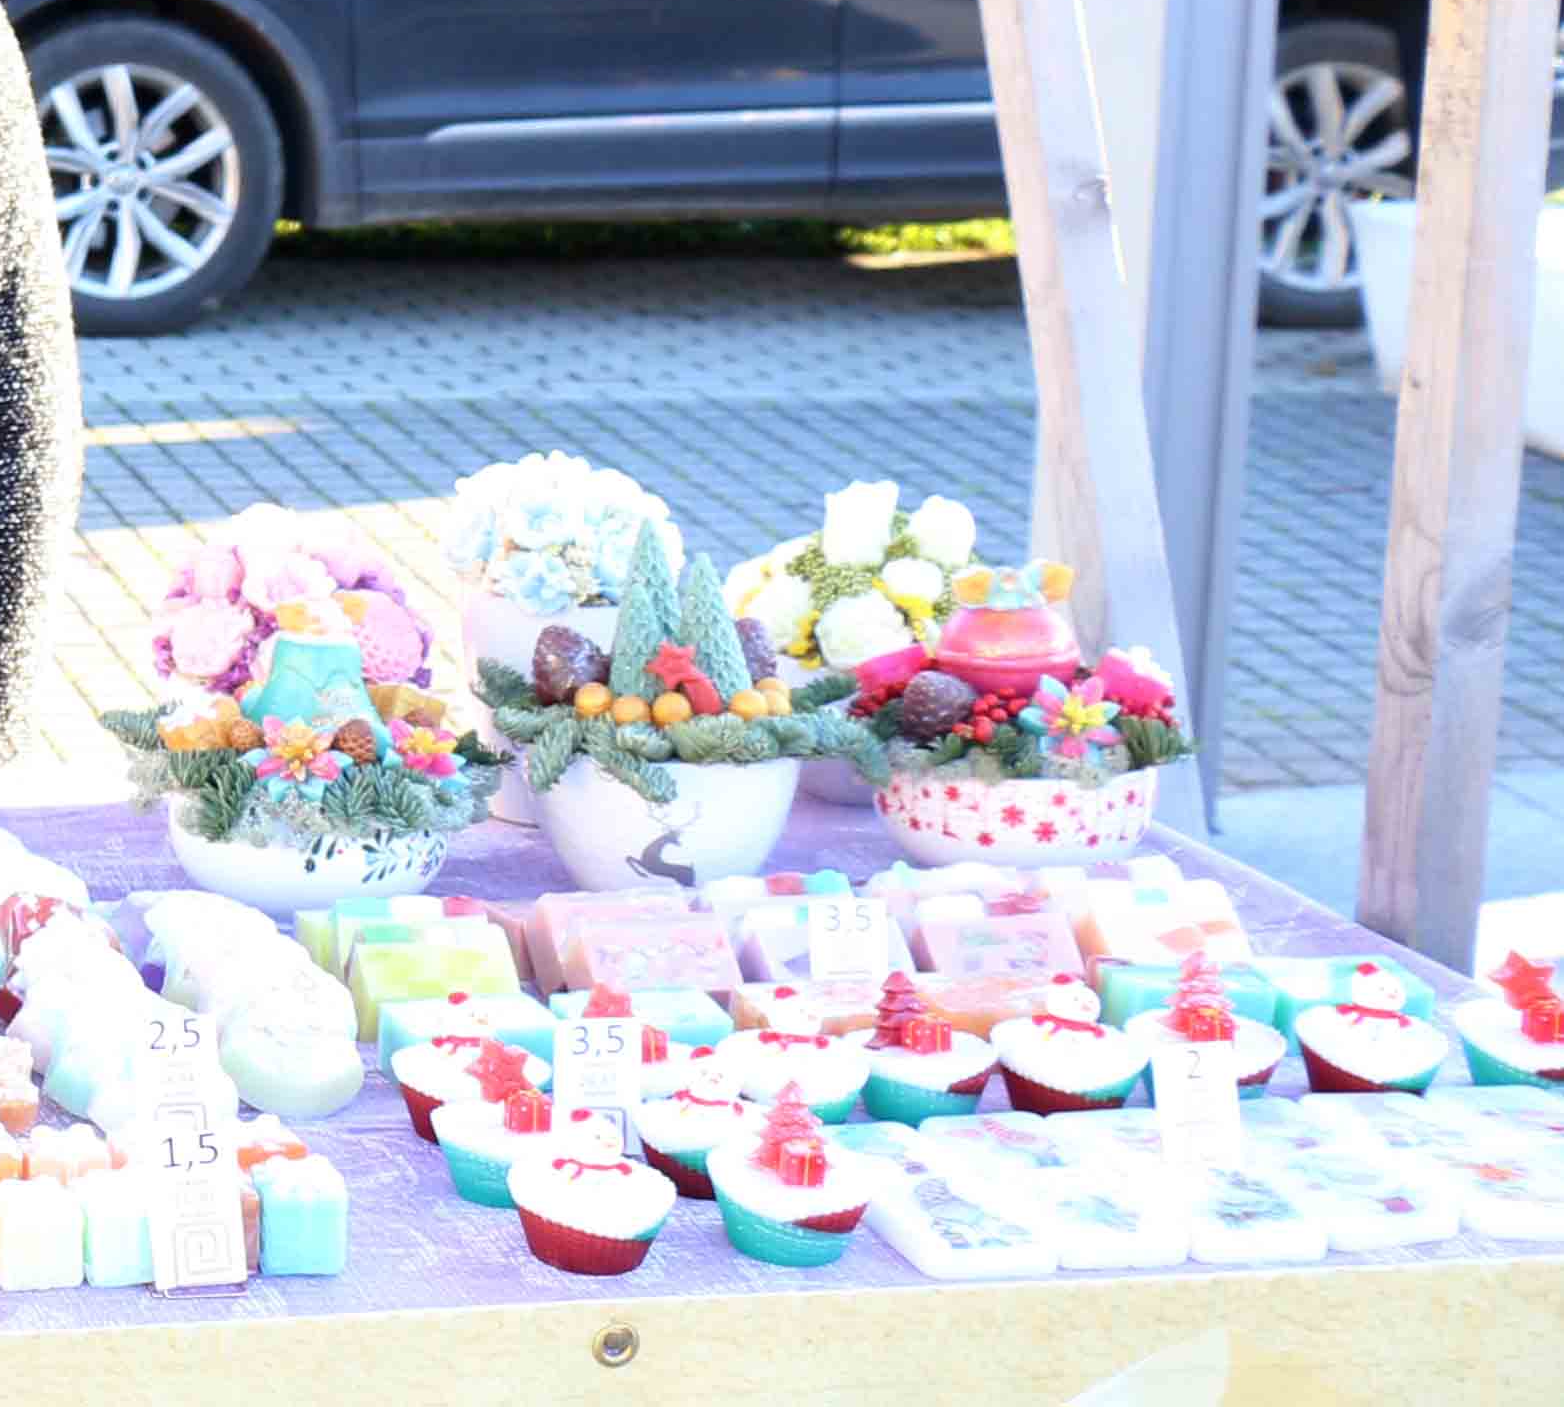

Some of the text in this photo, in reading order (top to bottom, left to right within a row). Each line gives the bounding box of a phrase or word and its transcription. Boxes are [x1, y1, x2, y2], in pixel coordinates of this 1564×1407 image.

[149, 1018, 202, 1054] 2,5
[572, 1025, 626, 1058] 3,5
[1186, 1049, 1201, 1080] 2
[161, 1132, 220, 1172] 1,5
